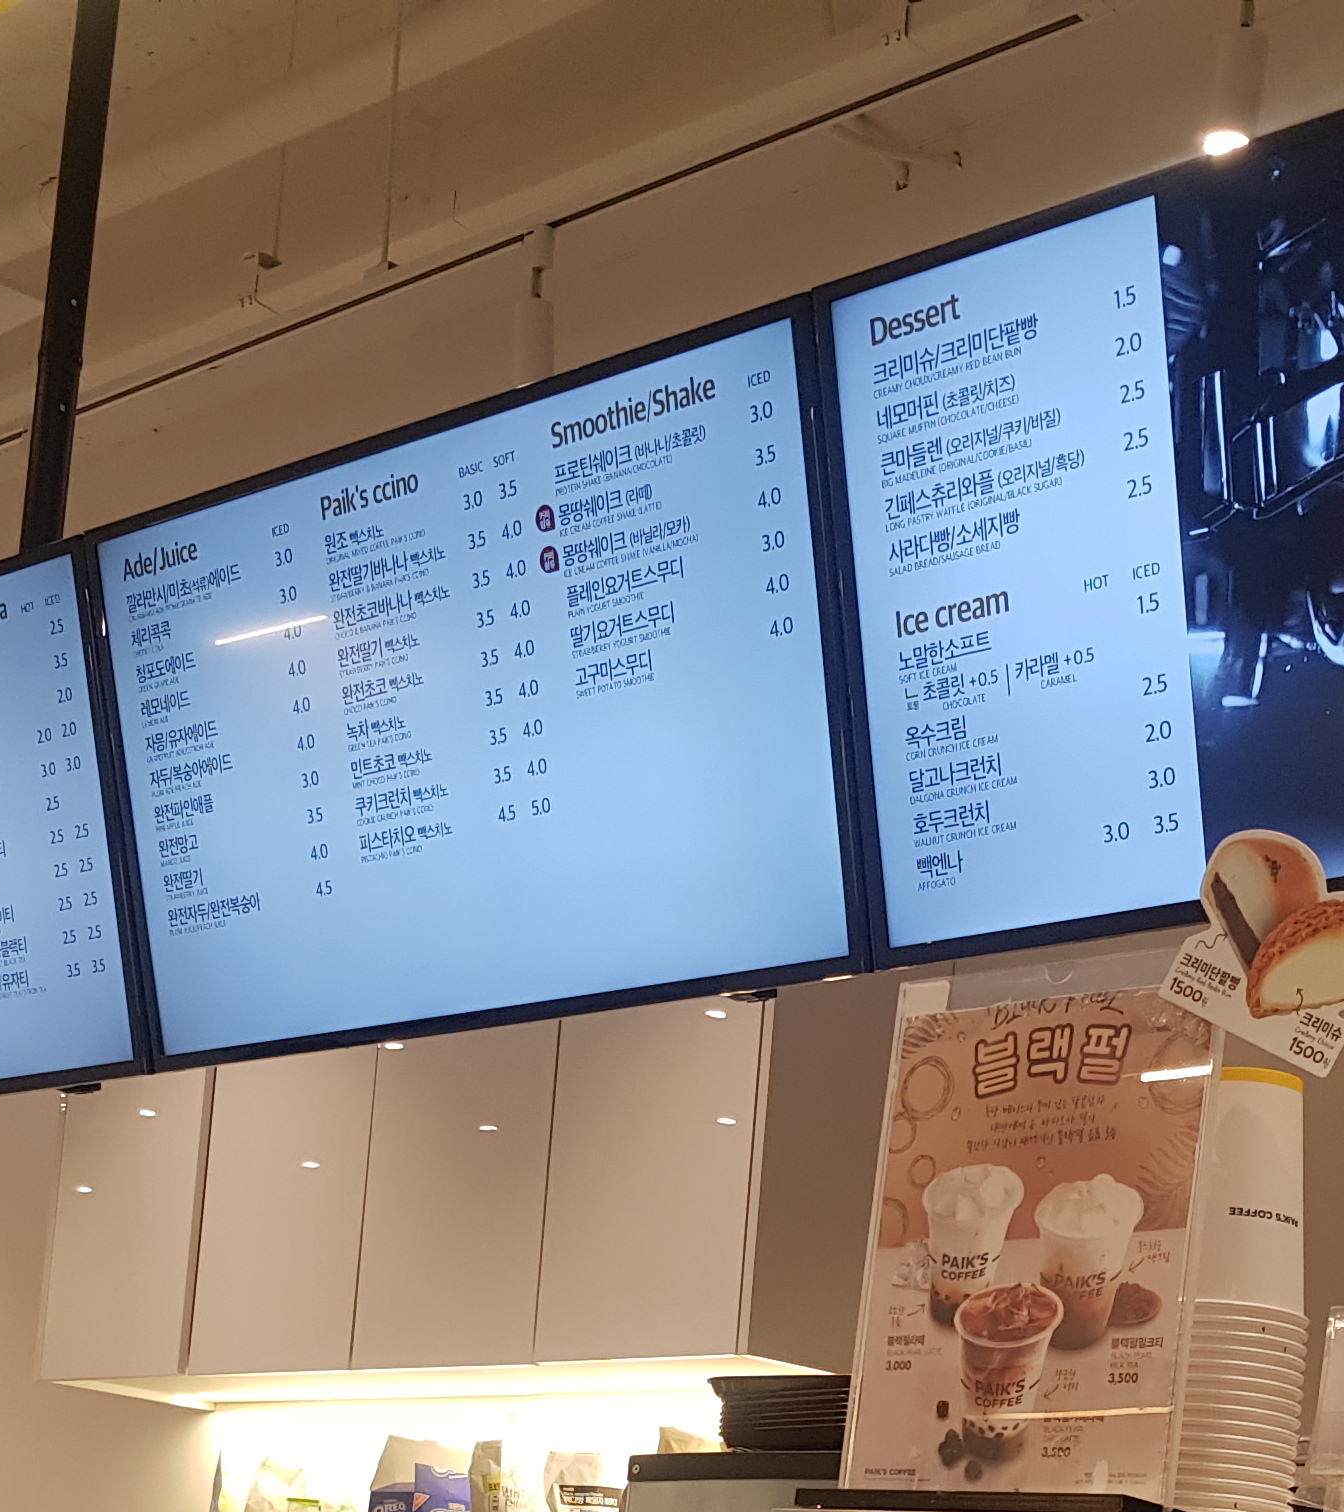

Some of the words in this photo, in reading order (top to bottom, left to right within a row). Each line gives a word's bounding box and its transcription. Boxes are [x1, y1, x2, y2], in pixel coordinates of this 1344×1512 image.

[1114, 285, 1136, 309] 1.5
[870, 294, 960, 346] Dessert
[1115, 333, 1142, 356] 2.0
[748, 371, 770, 388] ICED
[1120, 380, 1145, 404] 2.5
[551, 377, 716, 448] Smoothie/Shake
[877, 391, 938, 429] 네모머핀
[459, 461, 483, 479] BASIC
[493, 451, 515, 468] SOFT
[554, 445, 632, 484] 프로틴쉐이크
[881, 437, 943, 476] 큰마들렌
[320, 485, 368, 520] Paik's
[374, 474, 418, 504] ccino
[559, 491, 623, 526] 몽땅쉐이크
[757, 488, 781, 509] 4.0
[884, 470, 993, 521] 긴페스츄리와플
[324, 533, 348, 554] 원조
[563, 532, 627, 567] 몽땅쉐이크
[123, 542, 197, 581] Ade/Juice
[329, 551, 408, 592] 완전딸기바나나
[567, 556, 684, 608] 플레인요거트스무디
[1083, 575, 1109, 592] HOT
[1132, 563, 1161, 581] ICED
[333, 590, 412, 631] 완전초코바나나
[896, 609, 929, 638] Ice
[936, 590, 1009, 627] cream
[1137, 592, 1159, 615] 1.5
[570, 601, 675, 649] 딸기요거트스무디
[770, 617, 793, 638] 4.0
[338, 638, 383, 668] 완전딸기
[899, 631, 992, 671] 노말한소프트
[575, 649, 652, 687] 고구마스무디
[923, 674, 965, 702] 초콜릿
[1015, 652, 1058, 681] 카라멜
[342, 678, 387, 706] 완전초코
[1143, 674, 1167, 696] 2.5
[347, 719, 368, 741] 녹차
[906, 716, 967, 748] 옥수크림
[1145, 721, 1172, 743] 2.0
[351, 754, 396, 780] 민트초코
[909, 753, 1001, 793] 달고나크런치
[1148, 768, 1175, 789] 3.0
[356, 786, 411, 817] 쿠키크런치
[498, 805, 515, 822] 4.5
[532, 798, 550, 816] 5.0
[914, 800, 990, 835] 호두크런치
[1103, 822, 1130, 843] 3.0
[359, 826, 416, 853] 피스타치오
[316, 880, 332, 897] 4.5
[1300, 1012, 1342, 1041] 크리미슈
[973, 1023, 1131, 1099] 블랙펄
[942, 1253, 989, 1270] PAIK'S
